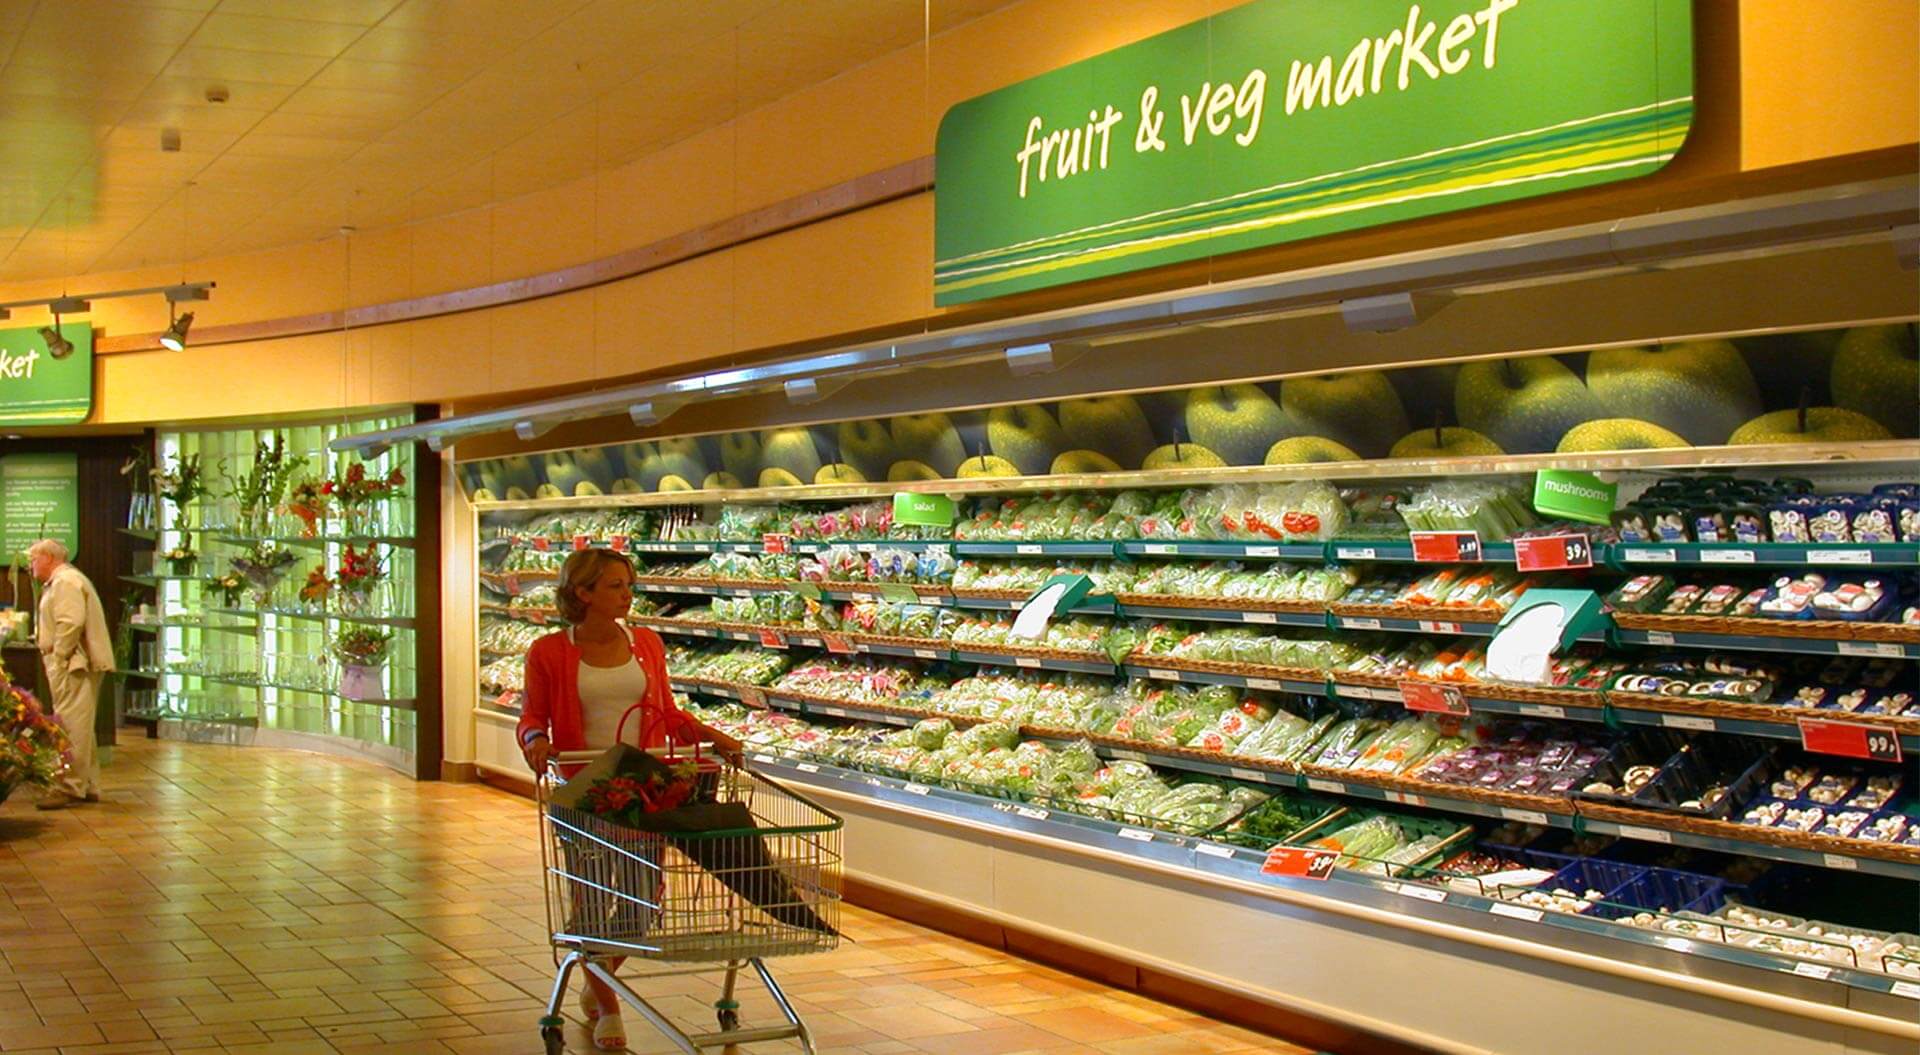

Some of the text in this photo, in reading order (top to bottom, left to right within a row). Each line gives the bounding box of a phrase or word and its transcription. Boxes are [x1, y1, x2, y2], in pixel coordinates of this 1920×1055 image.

[1017, 0, 1519, 198] fruit & veg market
[1545, 480, 1608, 502] mushrooms
[912, 501, 936, 512] salad
